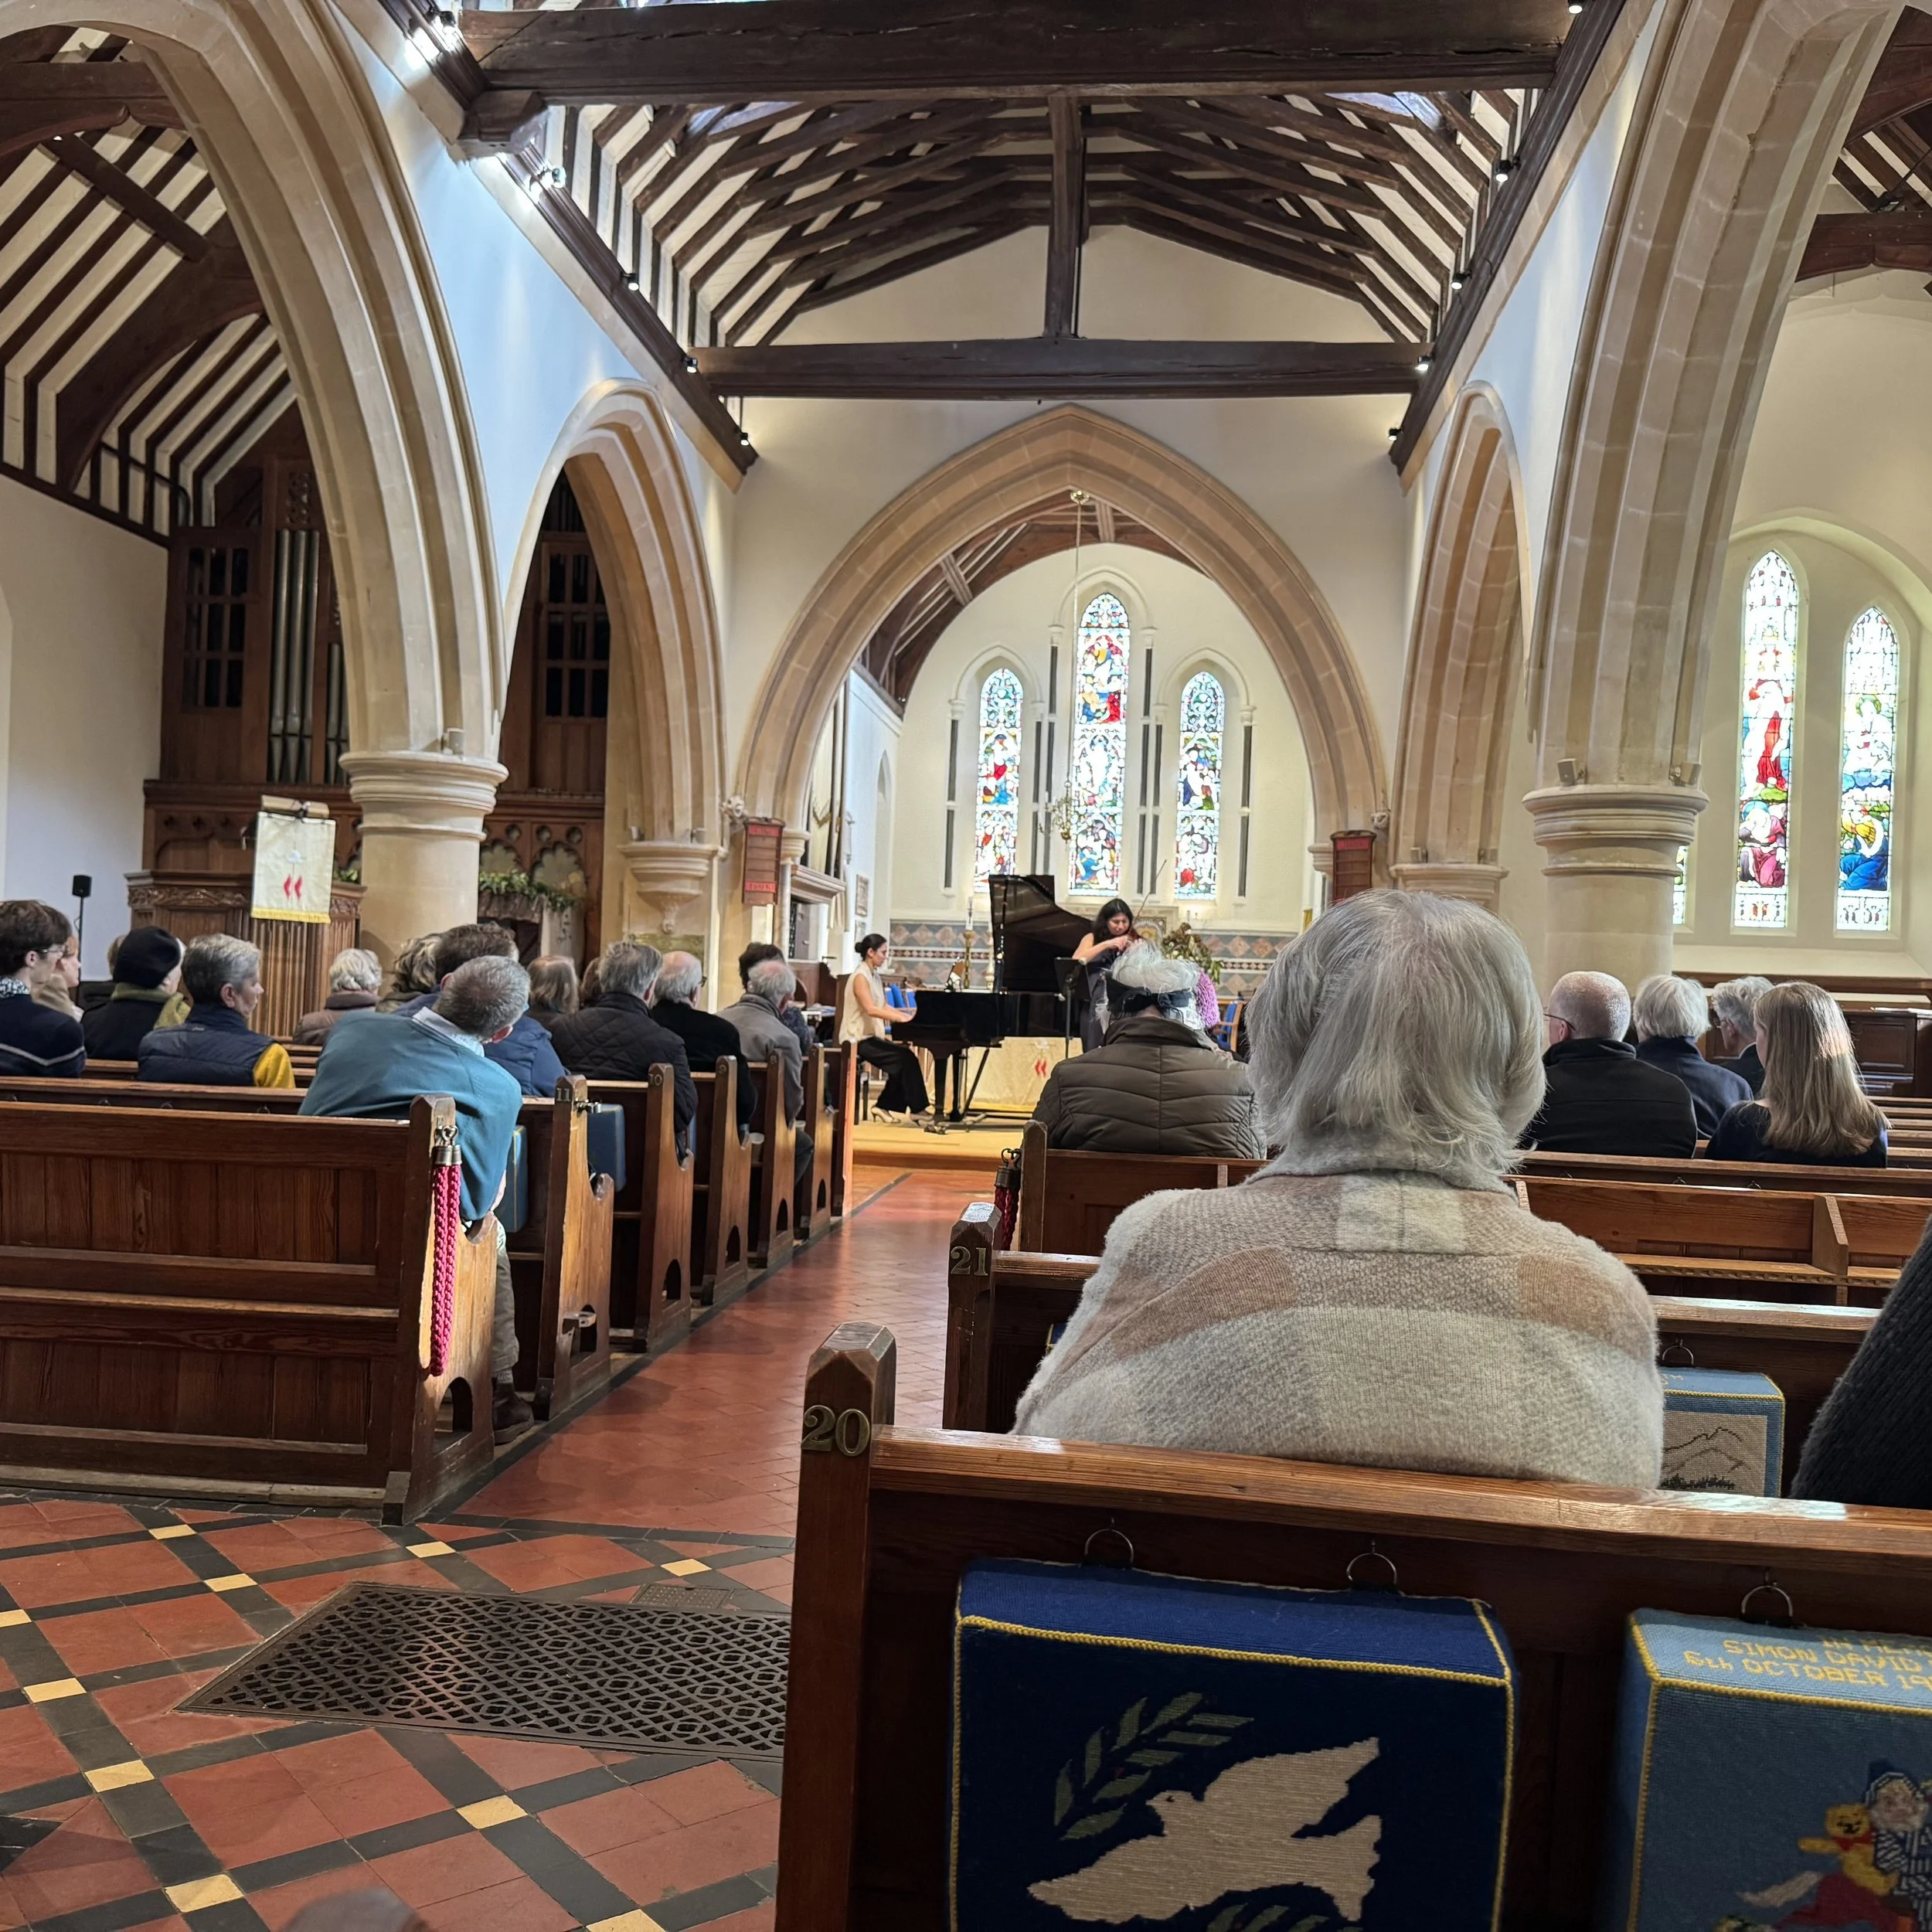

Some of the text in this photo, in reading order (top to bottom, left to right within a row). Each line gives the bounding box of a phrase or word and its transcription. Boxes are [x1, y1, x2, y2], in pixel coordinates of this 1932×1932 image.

[648, 1073, 663, 1086] 10
[719, 1064, 727, 1074] 9
[556, 1087, 570, 1102] 11
[951, 1246, 988, 1276] 21
[801, 1405, 870, 1457] 20
[1816, 1636, 1853, 1651] IN
[1723, 1640, 1922, 1672] SIMON DAVID
[1683, 1651, 1932, 1691] 6th OCTOBER 19
